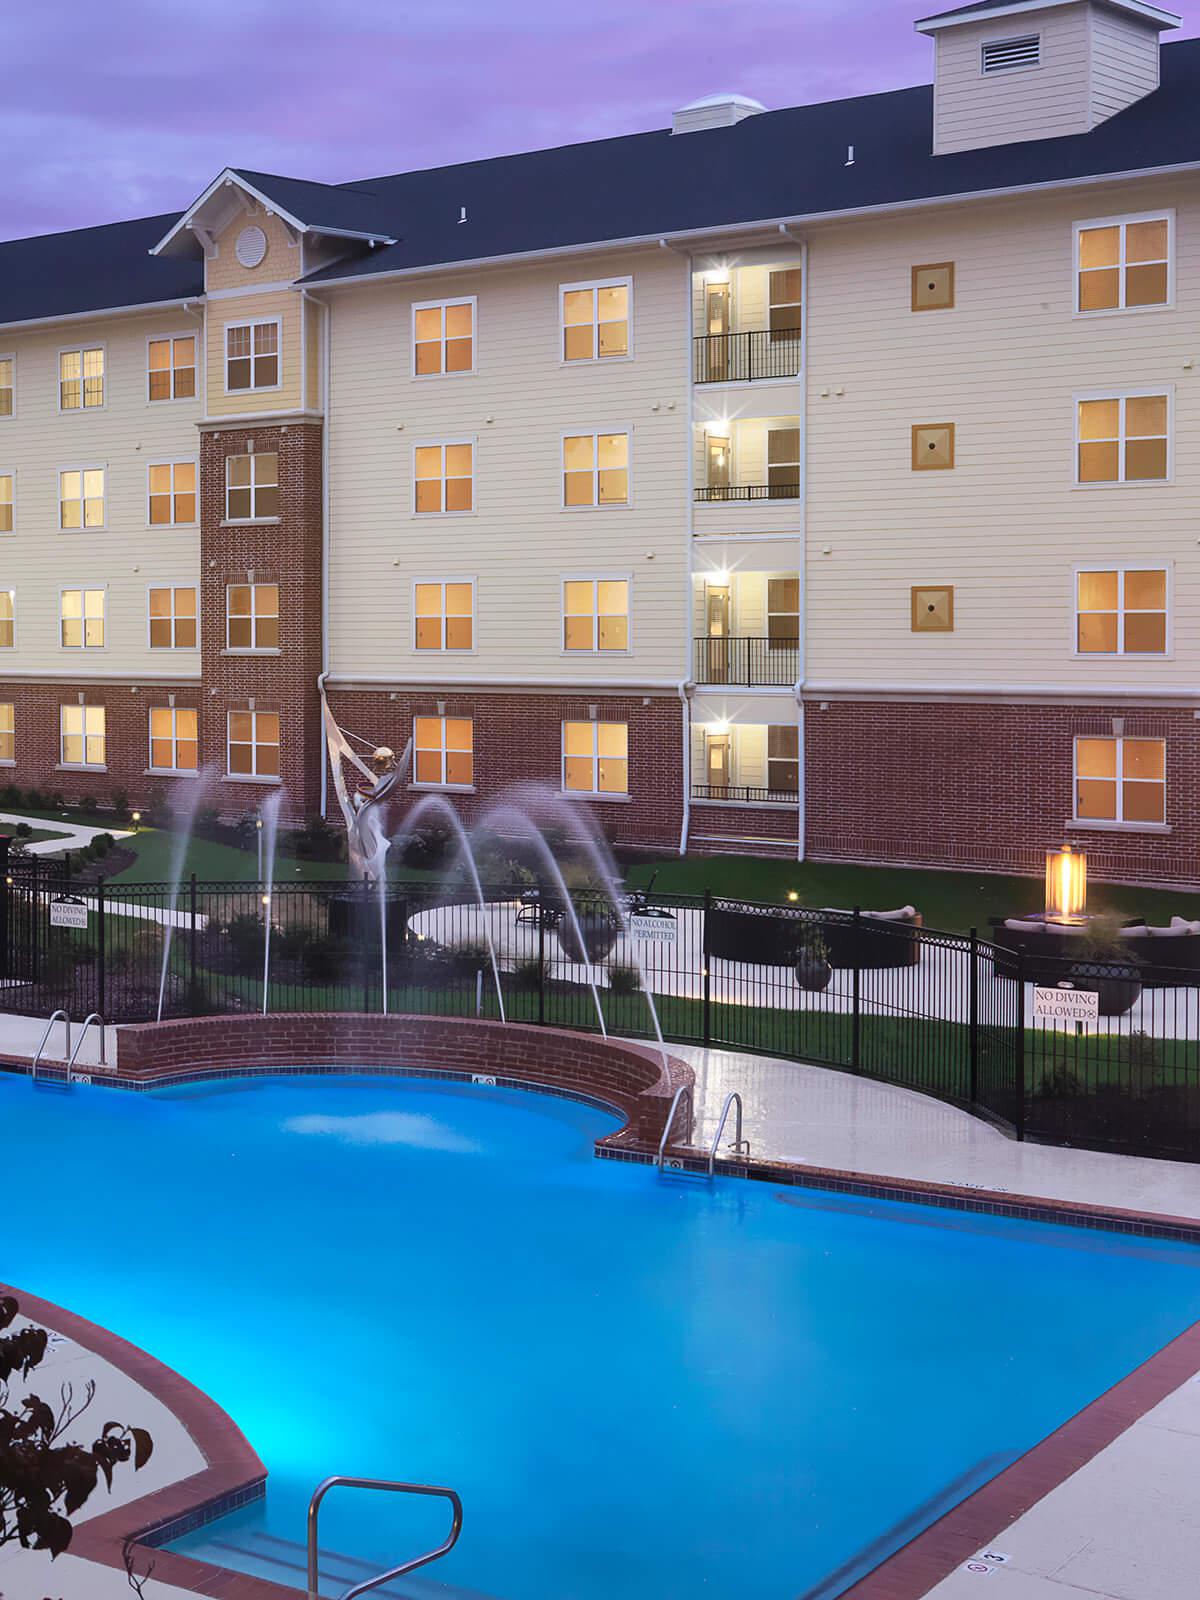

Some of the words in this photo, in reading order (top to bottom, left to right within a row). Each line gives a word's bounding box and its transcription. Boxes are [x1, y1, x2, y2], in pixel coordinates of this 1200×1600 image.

[51, 905, 62, 913] NO
[63, 906, 86, 915] DIVING
[52, 915, 81, 925] ALLOWED
[632, 919, 643, 927] NO
[644, 920, 676, 930] ALCOHOL
[634, 930, 675, 940] PERMITTED
[1036, 990, 1053, 1001] NO
[1056, 992, 1096, 1005] DIVING
[1036, 1005, 1087, 1018] ALLOWED
[984, 1554, 1005, 1562] 3
